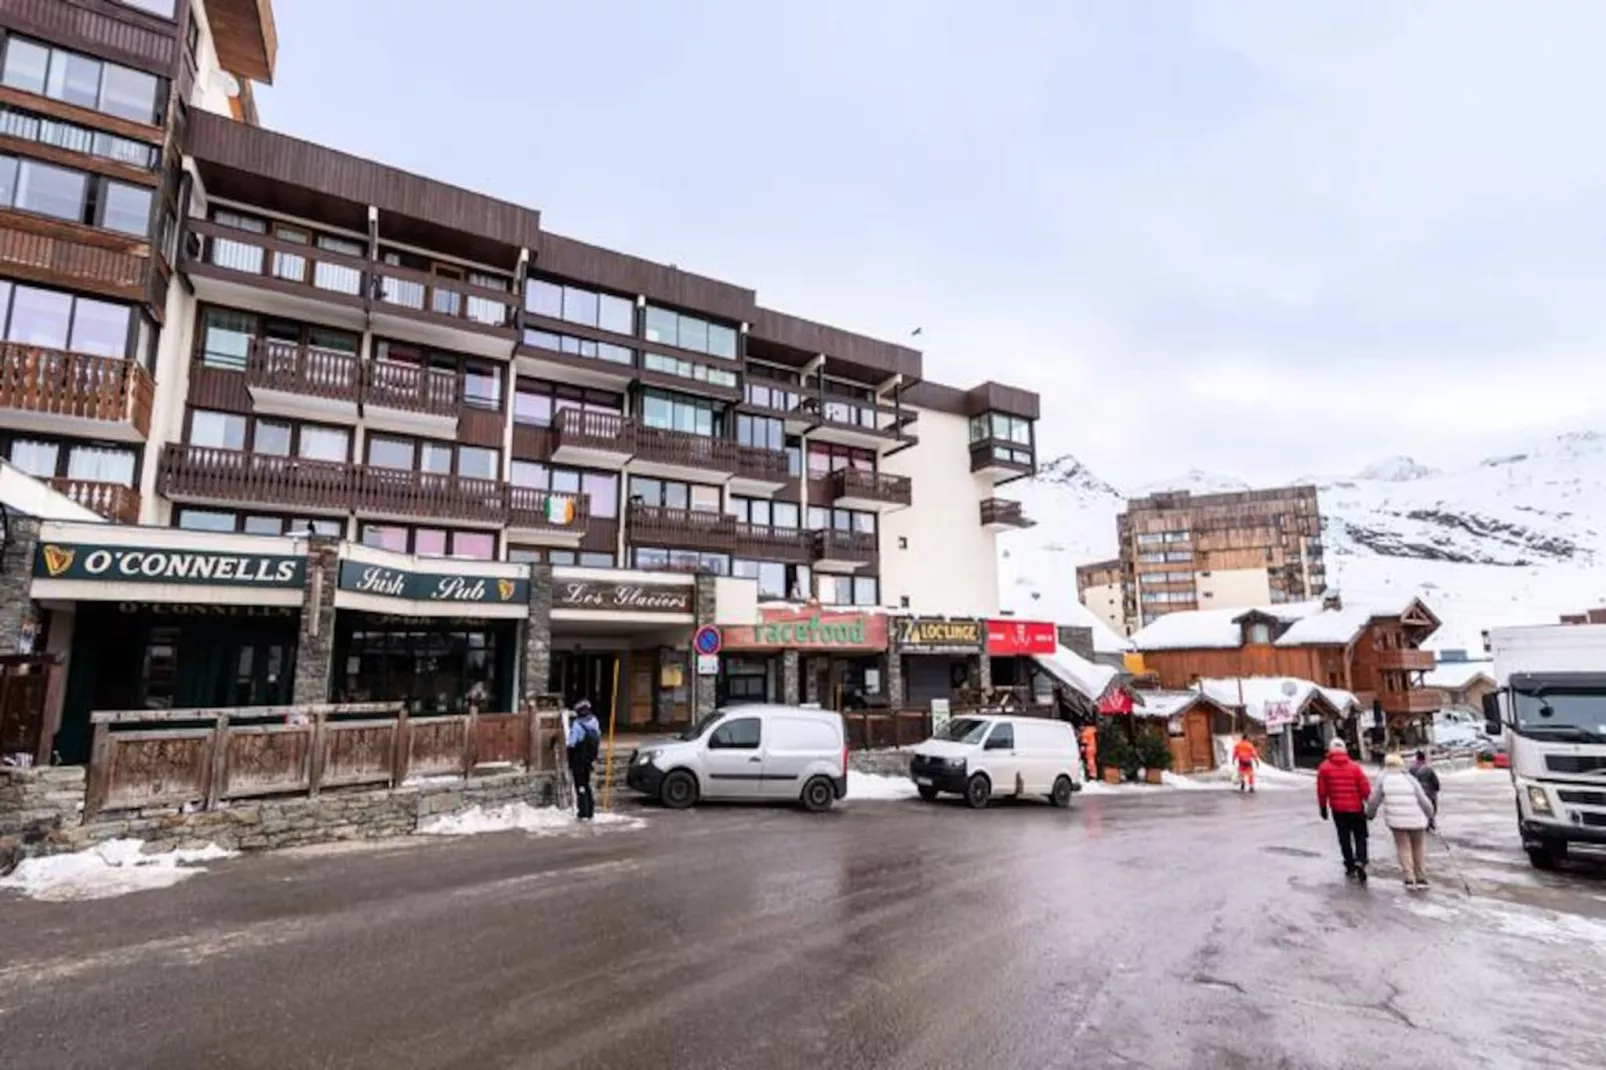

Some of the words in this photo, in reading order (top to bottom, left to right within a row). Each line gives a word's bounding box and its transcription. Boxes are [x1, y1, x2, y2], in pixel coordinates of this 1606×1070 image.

[84, 549, 296, 582] O'CONNELLS
[356, 566, 406, 595] Irish
[431, 576, 486, 601] Pub
[562, 583, 603, 605] Les
[613, 585, 688, 608] Glaciers
